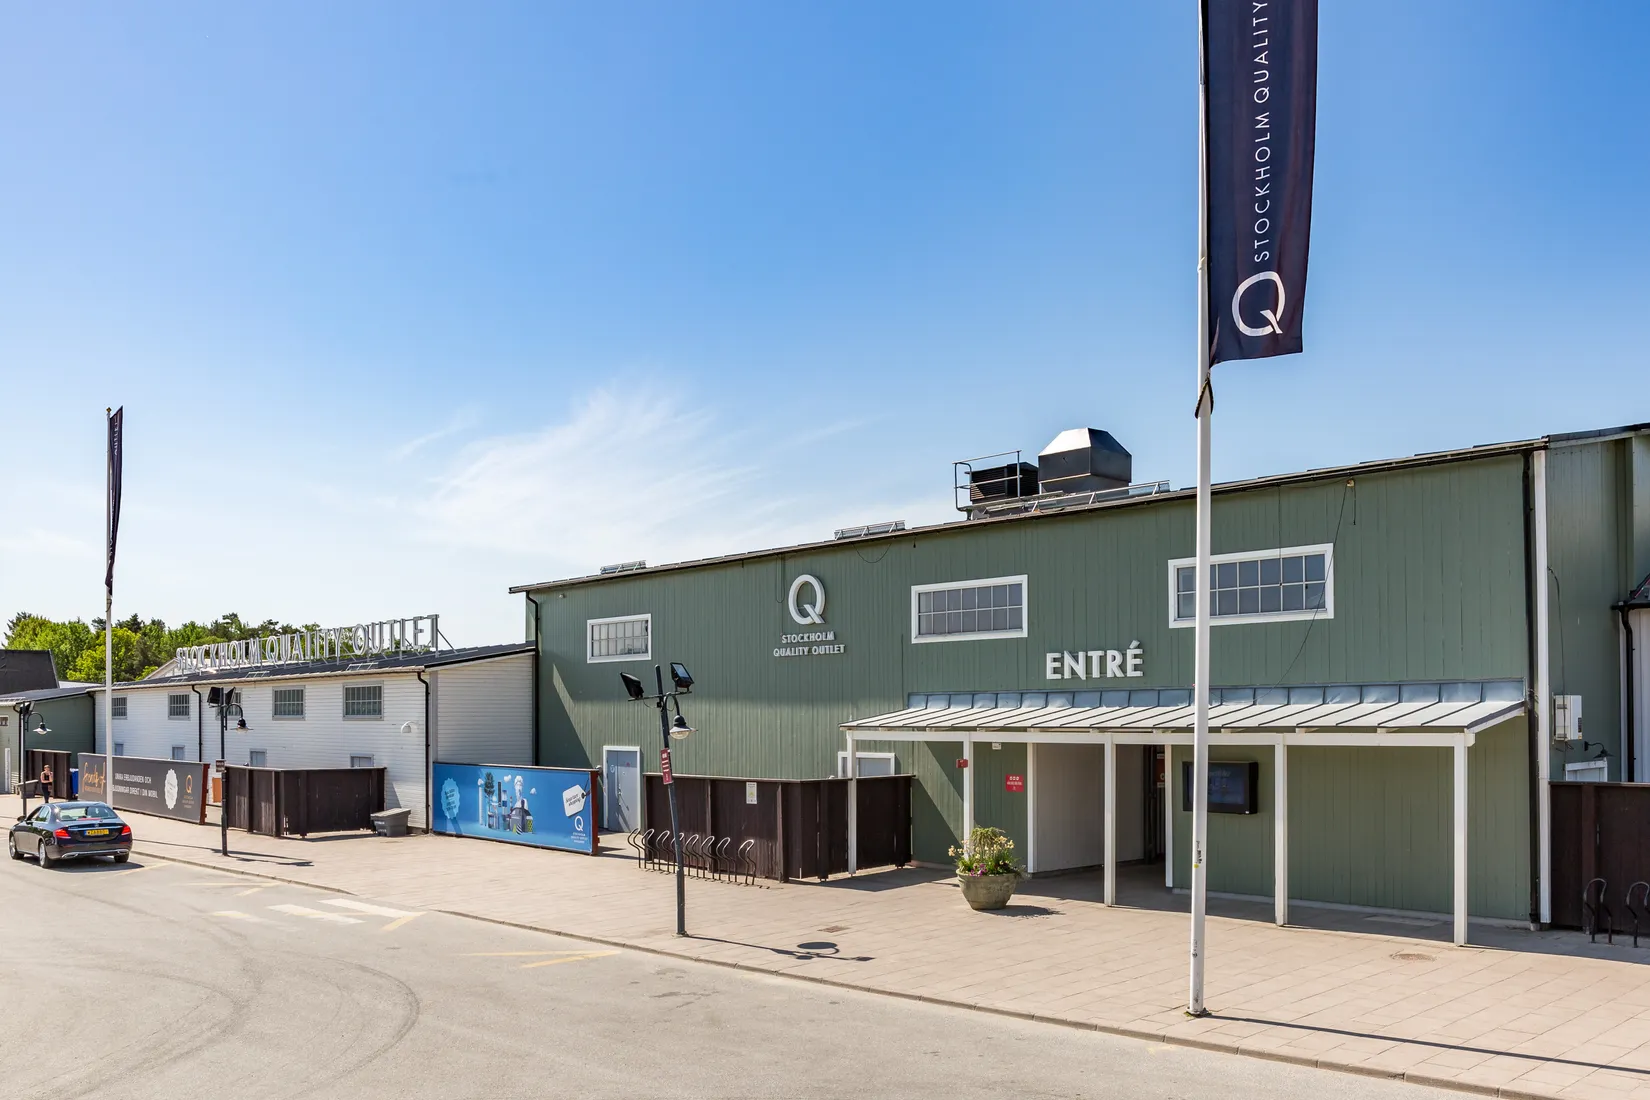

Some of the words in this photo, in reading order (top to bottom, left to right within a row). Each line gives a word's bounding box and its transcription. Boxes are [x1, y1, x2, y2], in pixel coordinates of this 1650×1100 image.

[1252, 2, 1270, 104] QUALITY
[1254, 111, 1271, 263] STOCKHOLM
[1231, 270, 1286, 337] Q
[788, 574, 826, 625] Q
[175, 637, 260, 673] STOCKHOLM
[265, 627, 344, 665] QUALITY
[352, 613, 439, 656] OUTLET
[773, 646, 810, 657] QUALITY
[811, 644, 846, 655] OUTLET
[781, 630, 836, 644] STOCKHOLM
[1046, 639, 1144, 681] ENTRÉ
[574, 815, 584, 832] Q
